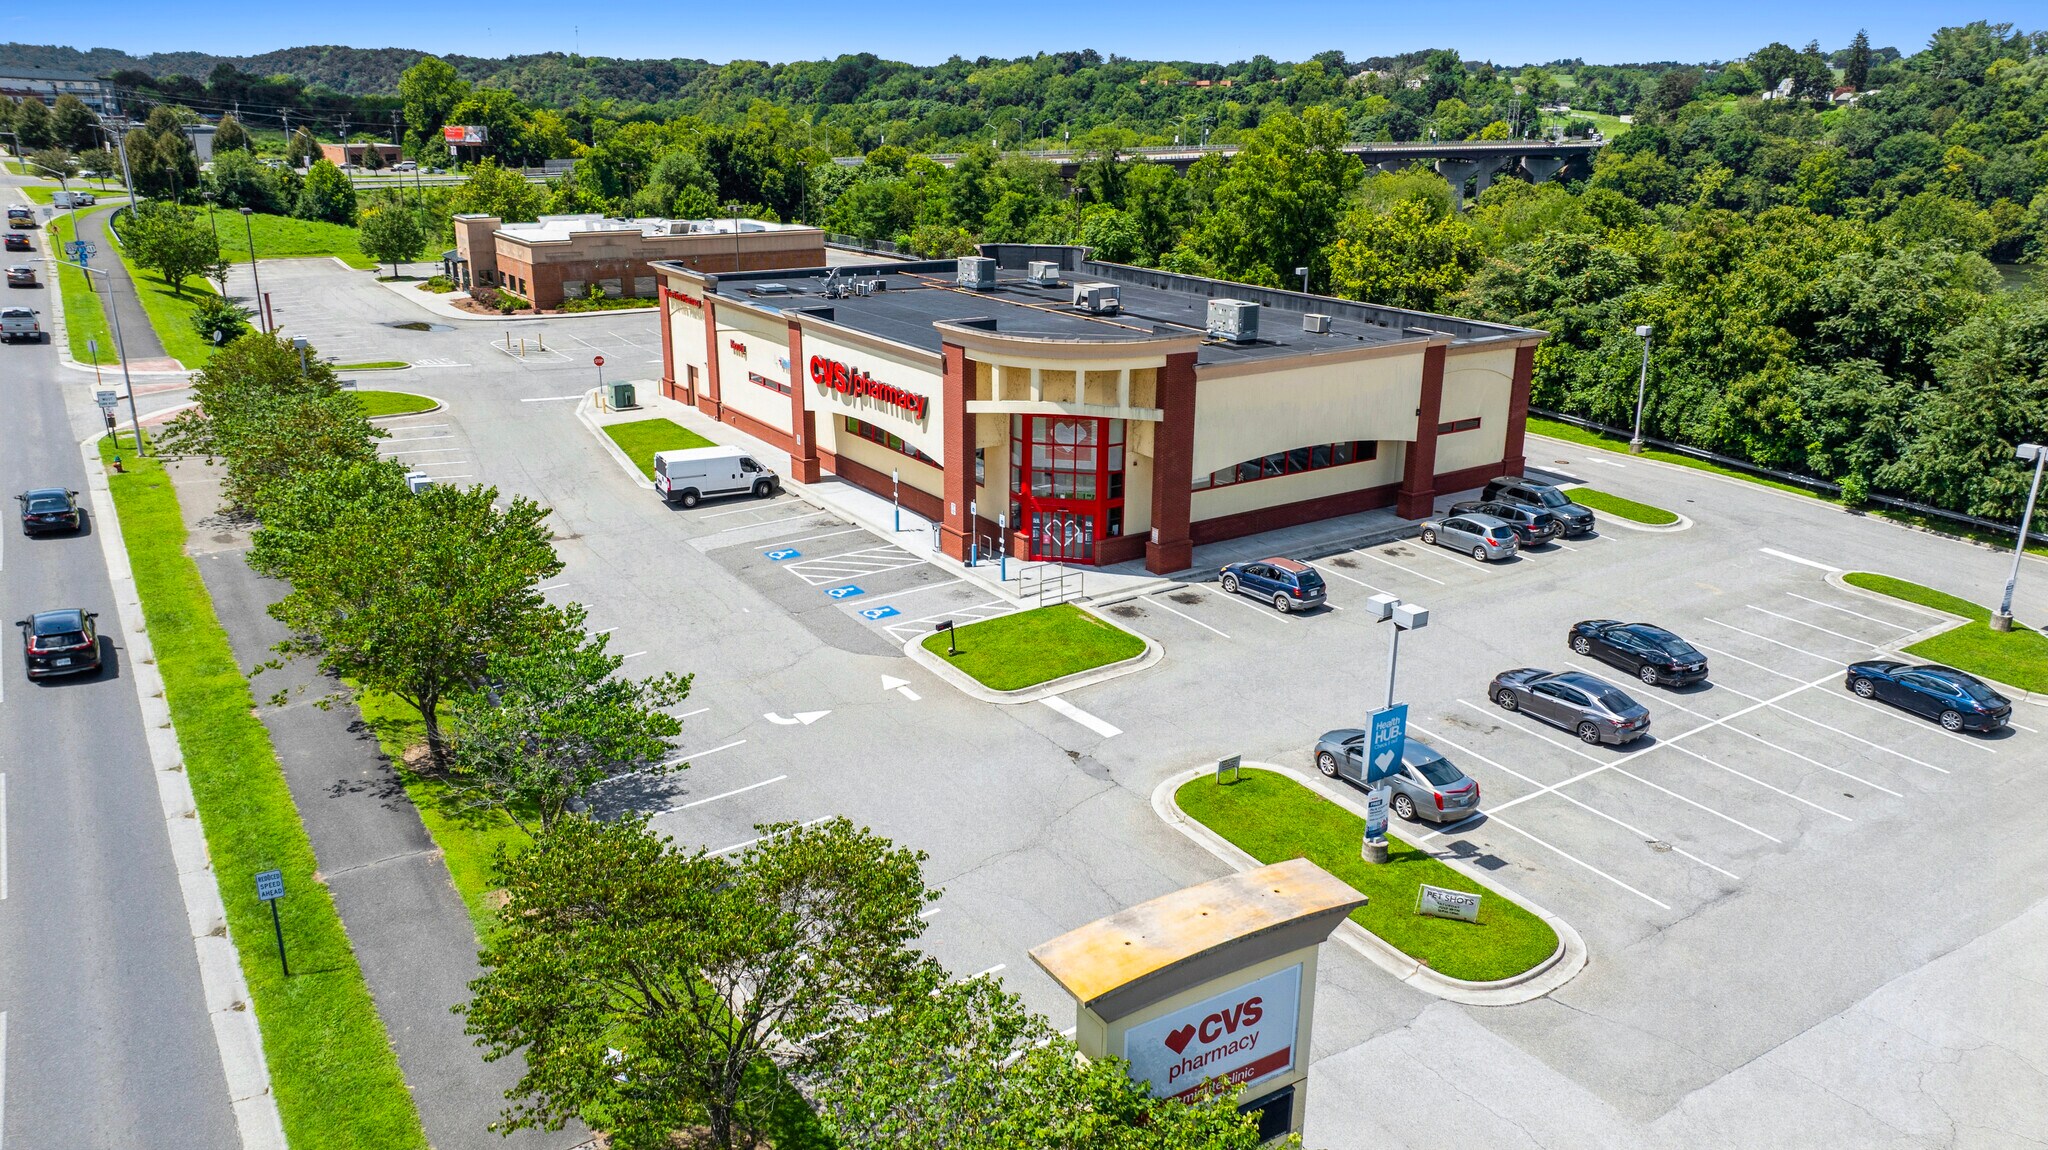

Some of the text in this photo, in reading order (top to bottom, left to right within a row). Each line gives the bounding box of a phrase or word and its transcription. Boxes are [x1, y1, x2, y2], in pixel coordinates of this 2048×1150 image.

[810, 355, 926, 420] CVS/pharmacy
[1376, 717, 1400, 731] Health
[1375, 726, 1399, 744] HUB
[260, 881, 280, 890] SPEED
[262, 889, 282, 897] AHEAD
[1427, 891, 1474, 905] PET SHOTS
[1198, 996, 1263, 1044] CVS
[1169, 1031, 1259, 1084] pharmacy
